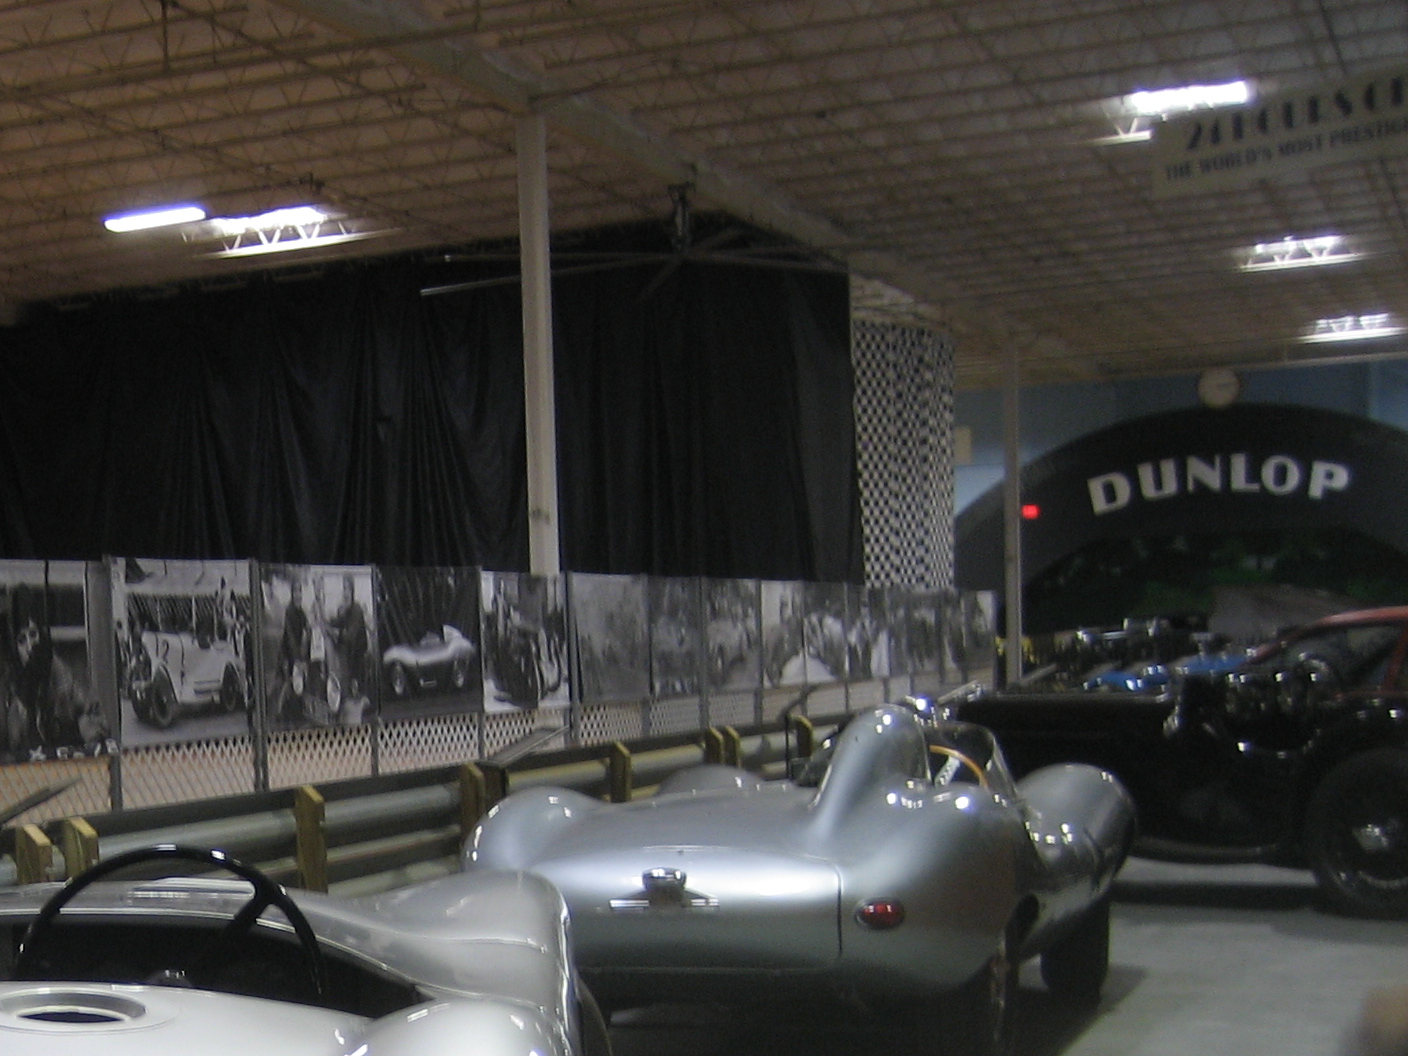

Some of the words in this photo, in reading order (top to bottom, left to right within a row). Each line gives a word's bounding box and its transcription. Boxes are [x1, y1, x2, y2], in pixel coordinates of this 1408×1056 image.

[1188, 119, 1222, 150] 24
[1232, 92, 1355, 142] HOURS
[1165, 160, 1191, 181] THE
[1278, 134, 1323, 156] MOST
[1087, 453, 1349, 516] DUNLOP
